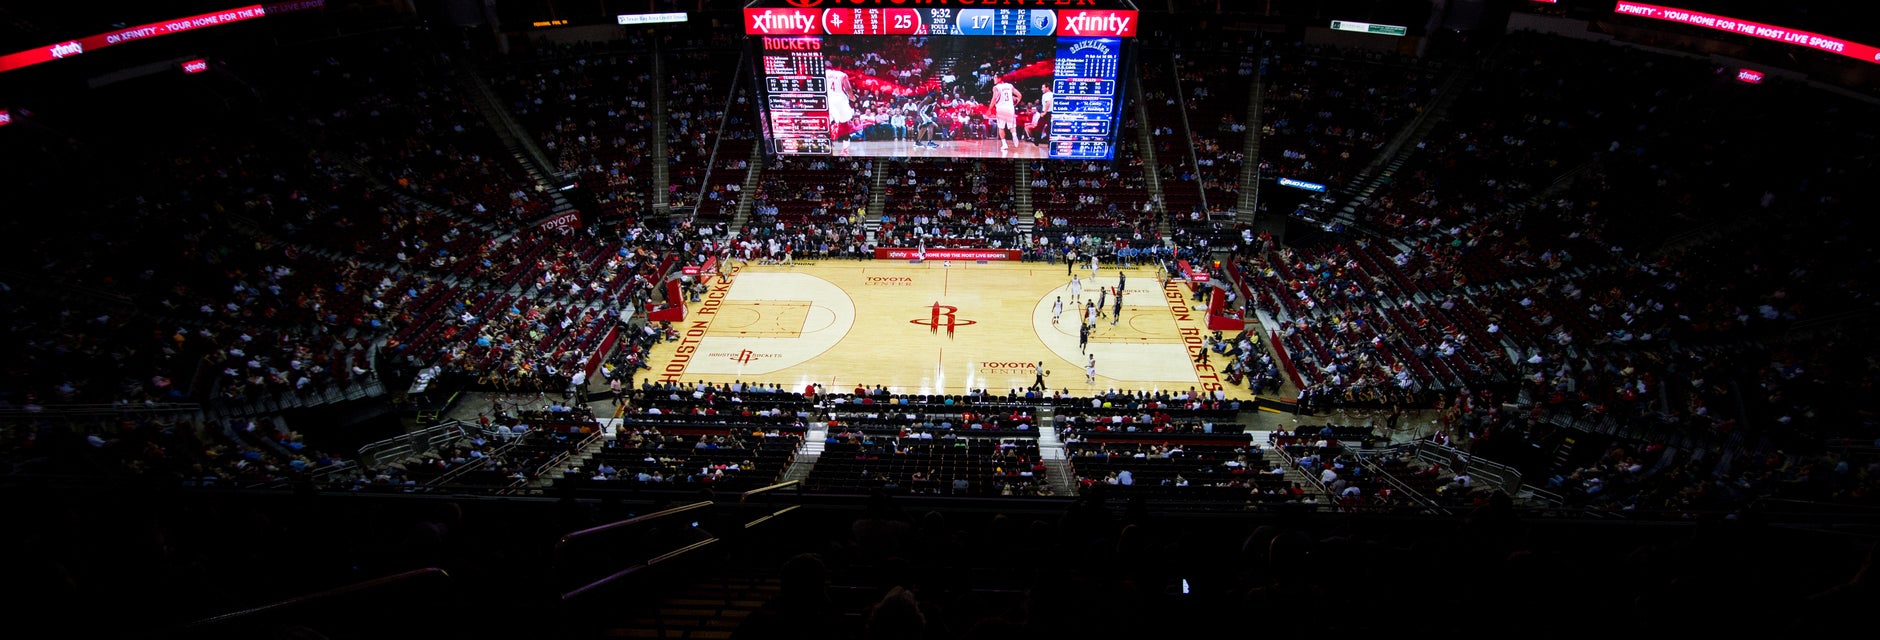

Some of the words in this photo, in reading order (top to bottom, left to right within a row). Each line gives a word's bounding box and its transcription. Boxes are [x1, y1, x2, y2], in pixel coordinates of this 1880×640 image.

[931, 8, 951, 18] 9:32
[106, 34, 121, 44] ON
[165, 20, 191, 32] YOUR
[192, 15, 218, 27] HOME
[219, 12, 236, 21] FOR
[238, 9, 253, 18] THE
[894, 15, 912, 29] 25
[972, 15, 990, 29] 17
[1618, 4, 1656, 15] XFINITY
[1663, 10, 1689, 21] YOUR
[1689, 15, 1715, 26] HOME
[1716, 20, 1735, 30] FOR
[1737, 23, 1756, 34] THE
[1756, 27, 1784, 39] MOST
[1785, 32, 1808, 44] LIVE
[1809, 37, 1844, 52] SPORTS
[50, 41, 83, 58] xfinity
[764, 37, 821, 50] ROCKETS
[1069, 40, 1110, 54] GRIZZLIES
[184, 62, 206, 73] xfinity
[1739, 71, 1762, 81] xfinity
[1004, 92, 1009, 101] 3
[541, 214, 577, 231] TOYOTA
[658, 321, 709, 383] HOUSTON
